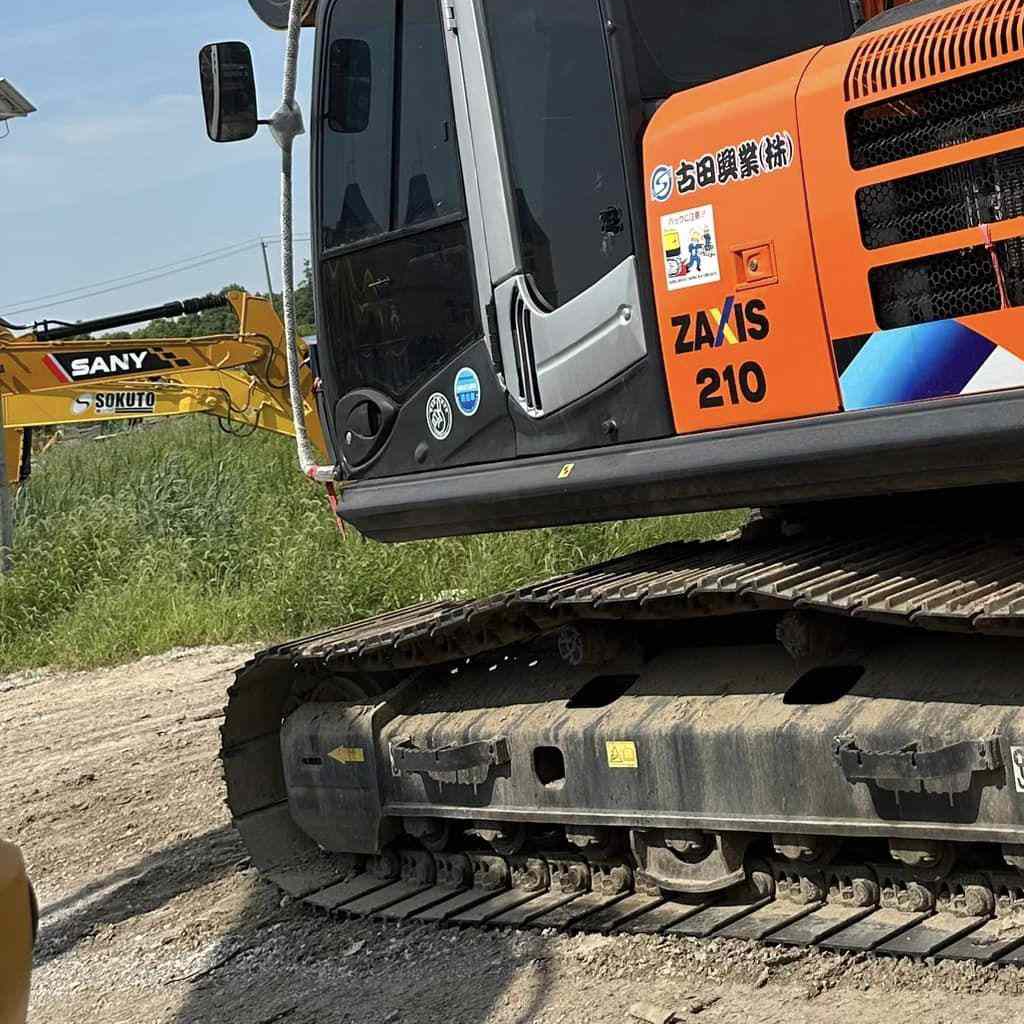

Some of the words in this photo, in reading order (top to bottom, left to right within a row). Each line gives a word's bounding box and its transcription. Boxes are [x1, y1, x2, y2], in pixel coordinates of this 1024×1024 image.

[671, 295, 770, 355] ZAXIS
[71, 351, 148, 377] SANY
[95, 391, 155, 408] SOKUTO
[696, 360, 767, 410] 210
